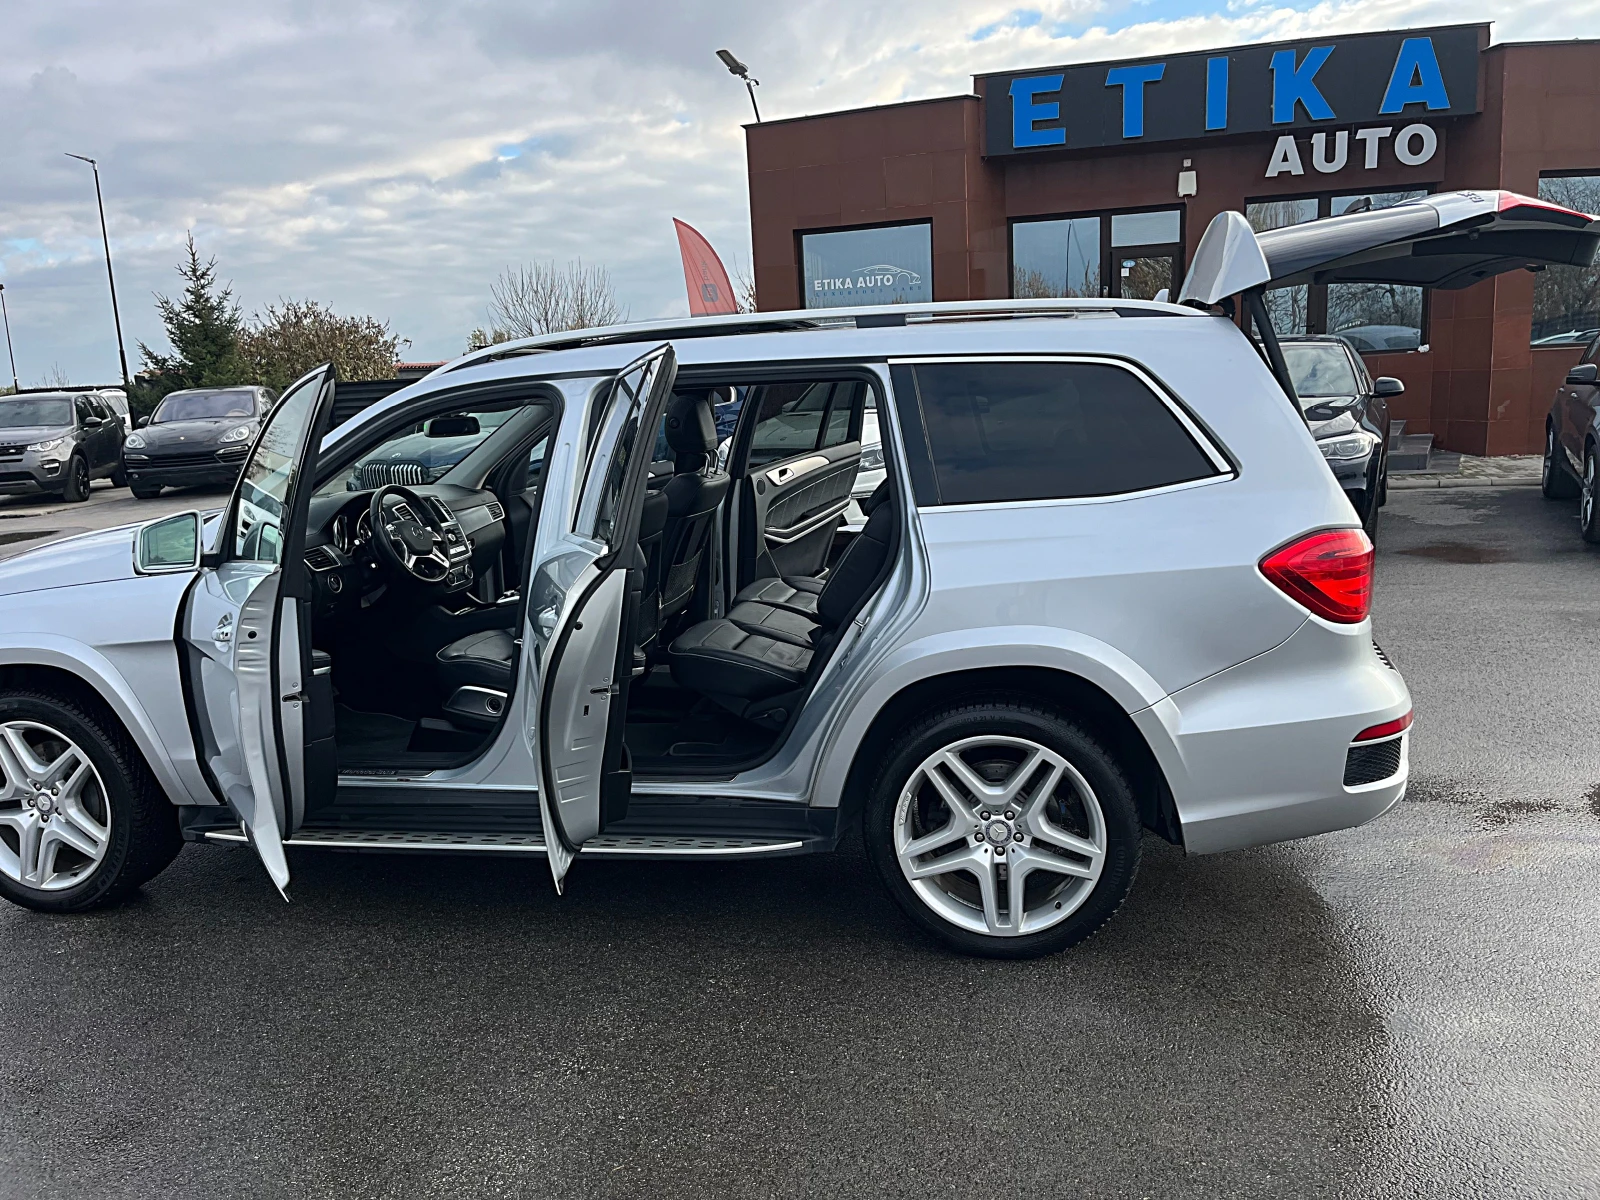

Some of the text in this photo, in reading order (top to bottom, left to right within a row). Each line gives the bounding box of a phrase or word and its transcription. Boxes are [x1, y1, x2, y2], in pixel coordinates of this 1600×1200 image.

[1008, 36, 1450, 149] ETIKA
[1264, 124, 1438, 178] AUTO
[814, 274, 894, 291] ETIKA AUTO
